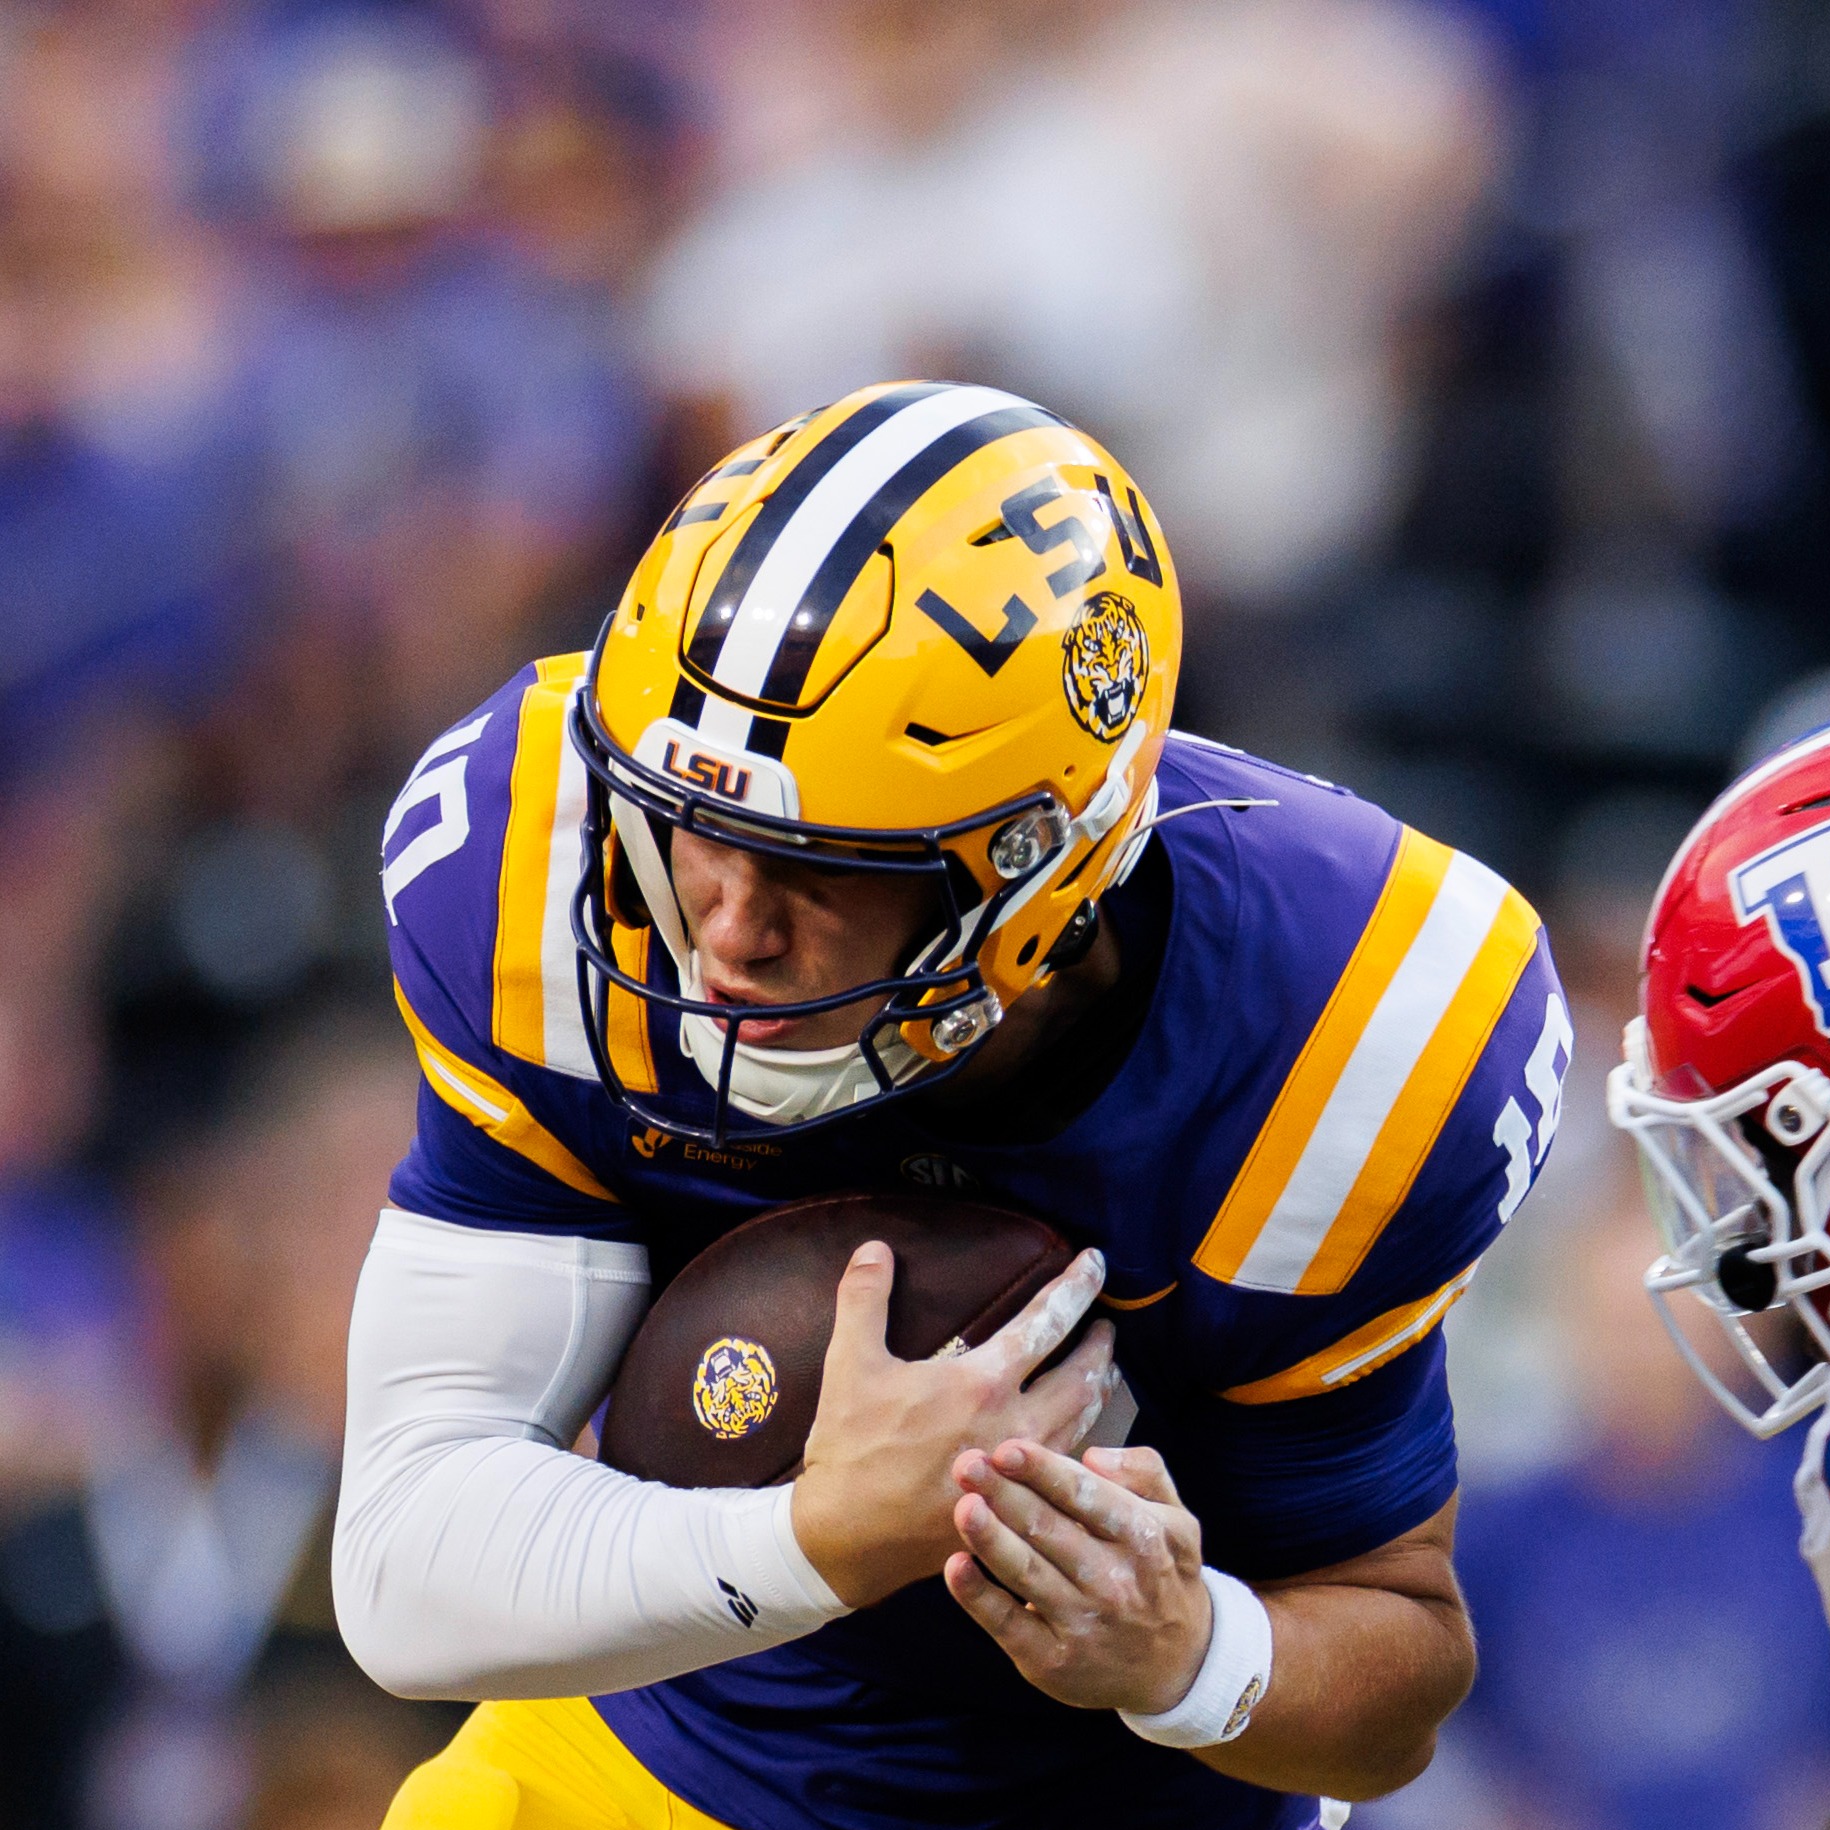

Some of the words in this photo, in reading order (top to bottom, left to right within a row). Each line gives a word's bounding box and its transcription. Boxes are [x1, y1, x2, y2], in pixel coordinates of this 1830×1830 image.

[916, 473, 1164, 678] LSU
[662, 740, 752, 802] LSU
[682, 1142, 759, 1172] Energy
